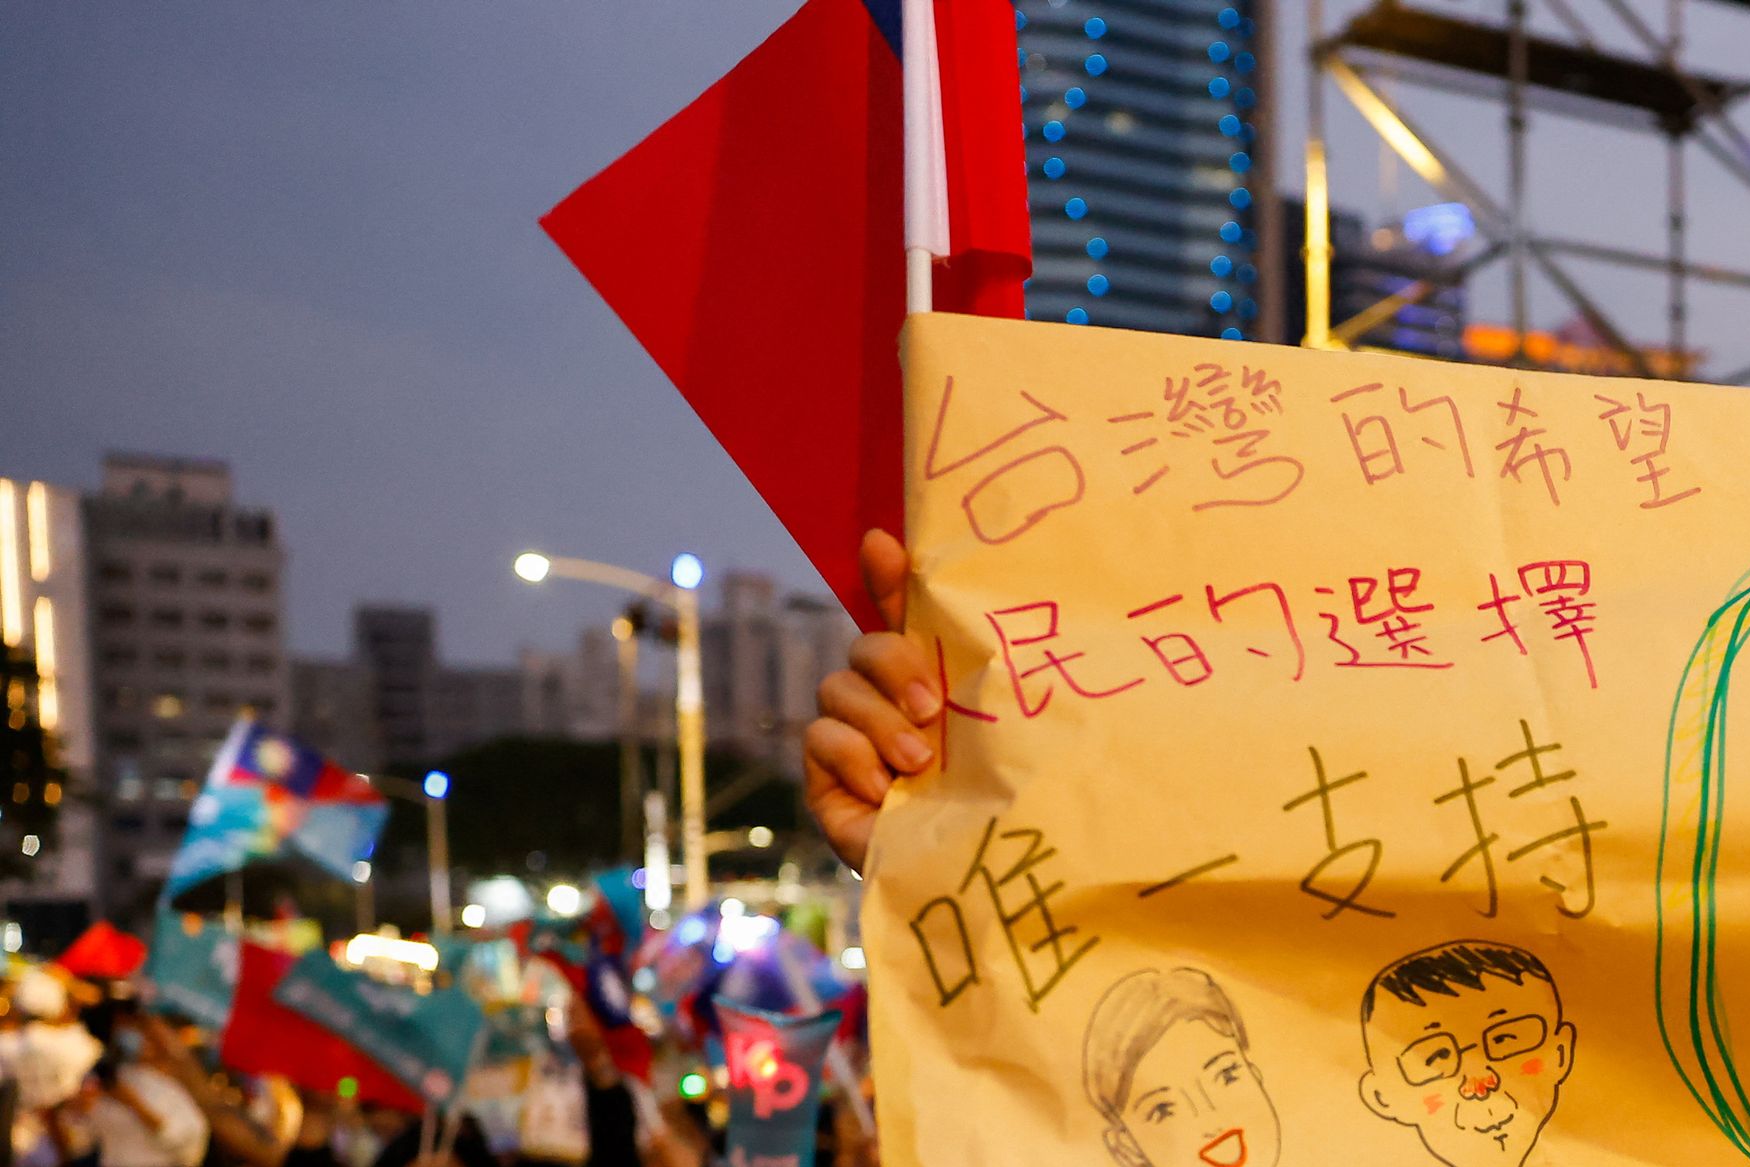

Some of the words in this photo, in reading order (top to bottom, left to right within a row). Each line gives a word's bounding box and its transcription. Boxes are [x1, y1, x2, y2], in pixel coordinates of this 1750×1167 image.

[924, 361, 1702, 545] 台灣的希望
[934, 559, 1599, 773] 人民的選擇
[909, 719, 1608, 1012] 唯一支持
